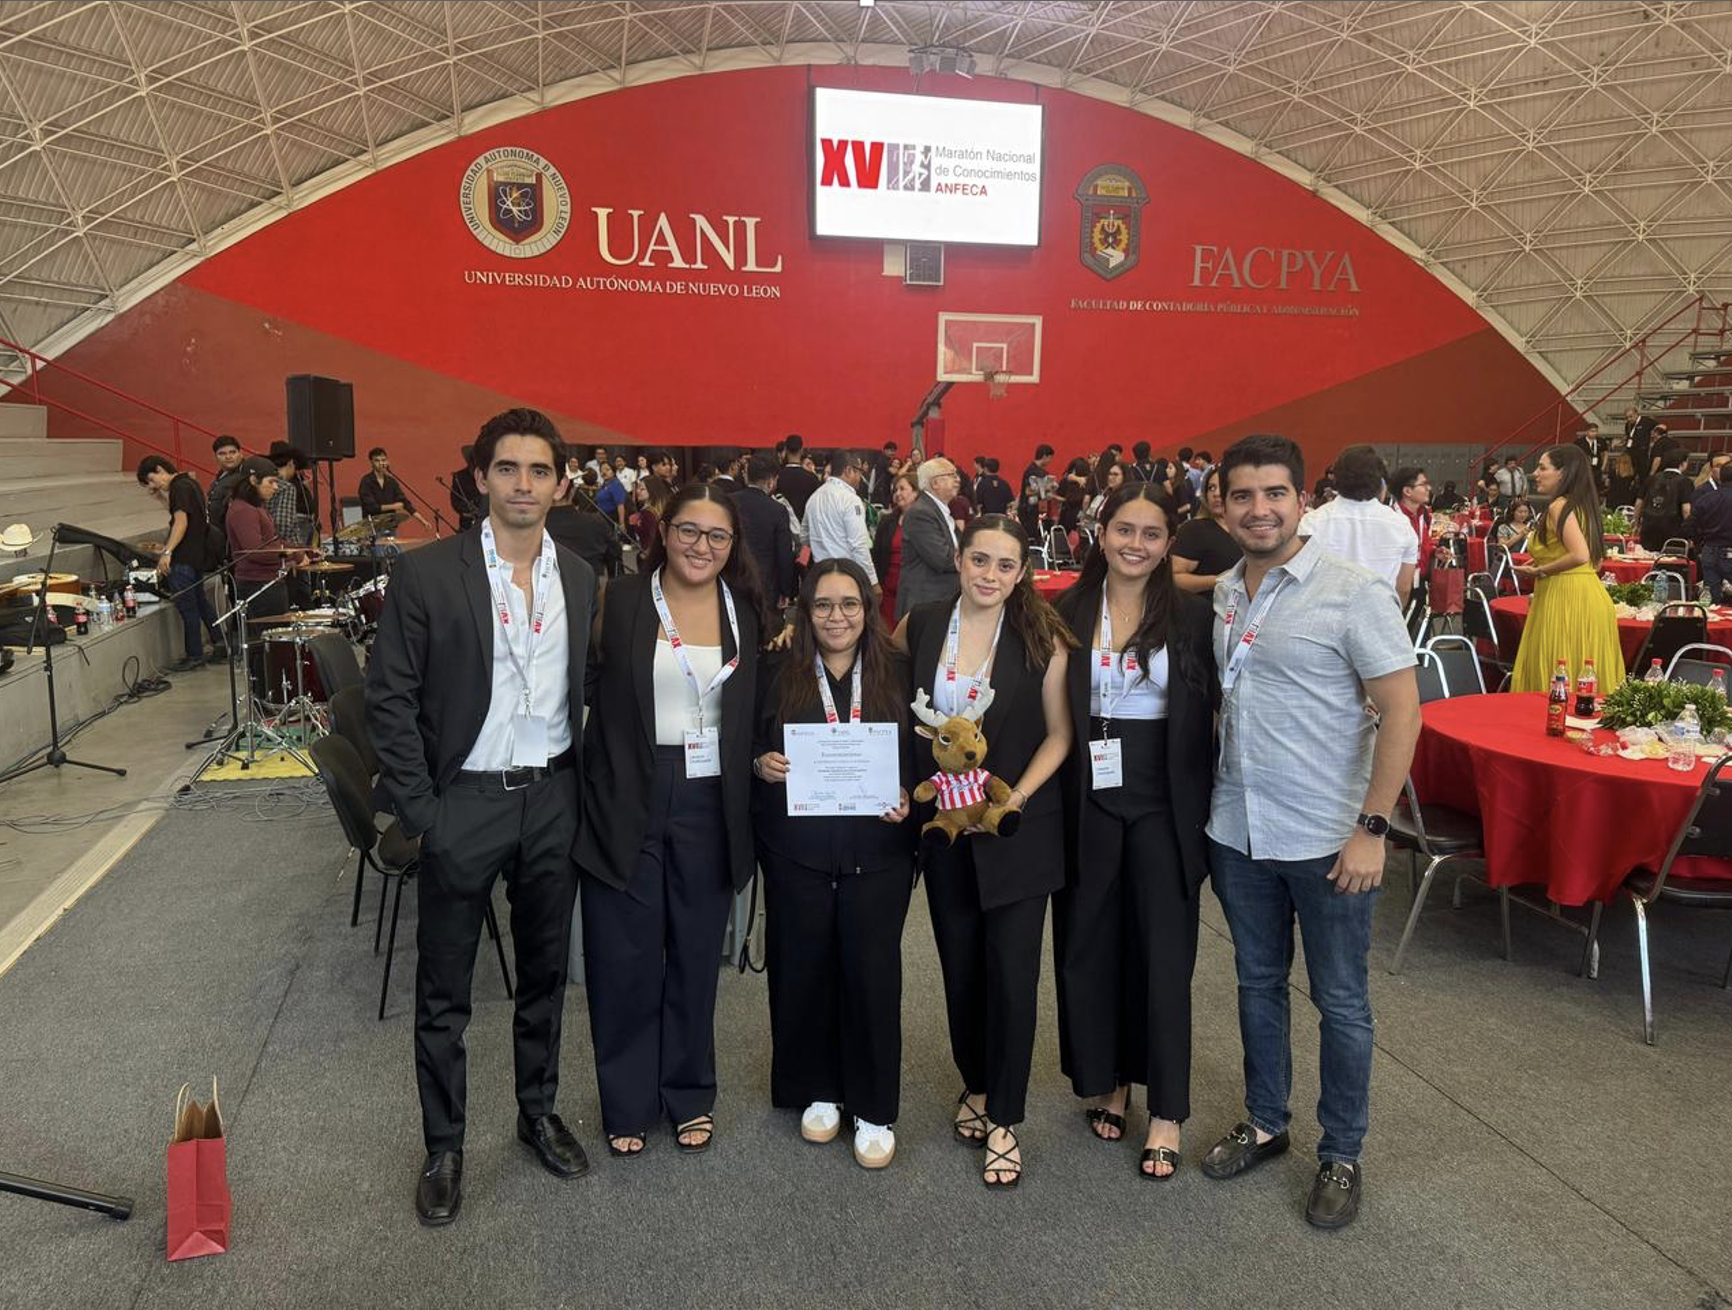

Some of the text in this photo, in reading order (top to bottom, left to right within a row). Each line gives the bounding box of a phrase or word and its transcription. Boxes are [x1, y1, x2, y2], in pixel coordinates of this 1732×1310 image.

[484, 149, 541, 167] AUTONOMA
[935, 145, 1035, 164] Maratón Nacional
[934, 163, 1037, 182] de Conocimientos
[461, 162, 483, 231] UNIVERSIDAD
[550, 172, 568, 207] NUEVO
[934, 182, 988, 197] ANFECA
[552, 210, 568, 237] LEON
[591, 206, 783, 273] UANL
[1190, 243, 1361, 293] FACPYA
[464, 270, 572, 288] UNIVERSIDAD
[576, 274, 663, 293] AUTÓNOMA
[666, 280, 687, 294] DE
[688, 281, 740, 297] NUEVO
[1070, 297, 1127, 310] FACULTAD
[1129, 300, 1144, 311] DE
